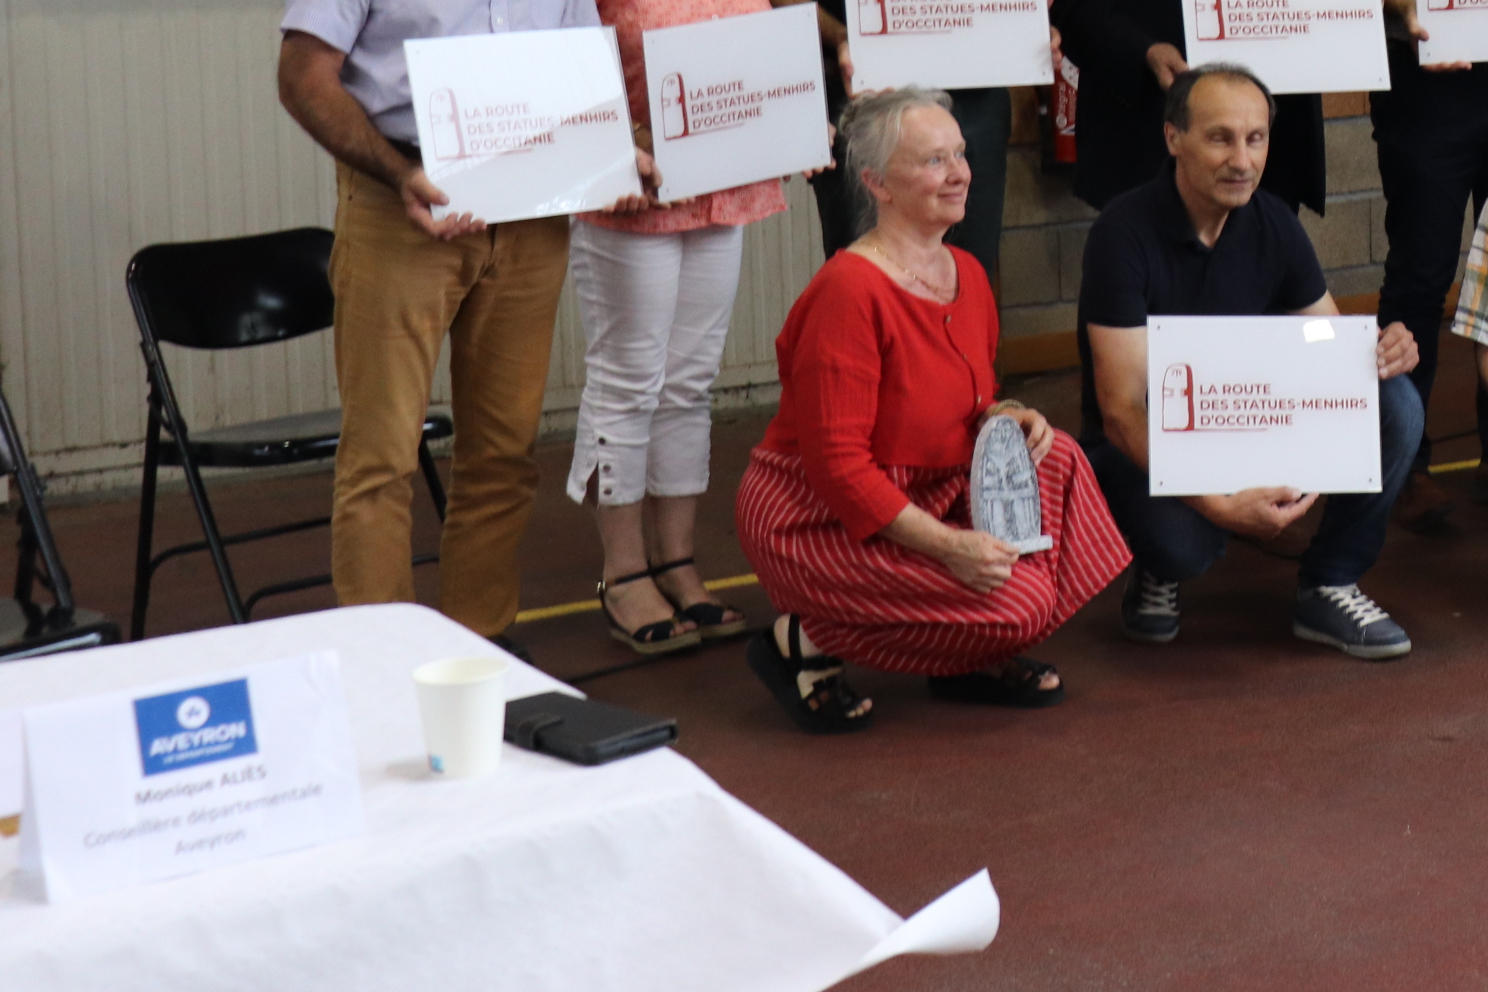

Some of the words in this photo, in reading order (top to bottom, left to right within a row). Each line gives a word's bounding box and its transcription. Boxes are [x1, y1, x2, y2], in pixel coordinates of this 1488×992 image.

[891, 4, 918, 14] DES
[920, 0, 1037, 14] STATUES-MENHIRS
[1227, 0, 1243, 8] LA
[892, 16, 973, 29] D'OCCITANIE
[1228, 12, 1253, 22] DES
[1256, 9, 1373, 21] STATUES-MENHIRS
[1229, 23, 1310, 35] D'OCCITANIE
[689, 90, 704, 100] LA
[707, 80, 744, 97] ROUTE
[691, 102, 713, 114] DES
[716, 80, 816, 110] STATUES-MENHIRS
[464, 107, 482, 119] LA
[486, 102, 530, 117] ROUTE
[693, 106, 762, 129] D'OCCITANIE
[467, 121, 495, 134] DES
[497, 110, 618, 131] STATUES-MENHIRS
[470, 131, 555, 150] D'OCCITANIE
[1199, 384, 1218, 395] LA
[1222, 383, 1272, 395] ROUTE
[1200, 399, 1229, 411] DES
[1233, 397, 1368, 410] STATUES-MENHIRS
[1200, 413, 1293, 426] D'OCCITANIE
[149, 721, 246, 757] AVEYRON
[135, 779, 214, 804] Monique
[84, 814, 182, 848] Conseillère
[187, 784, 323, 824] départementale
[175, 829, 246, 855] Aveyron
